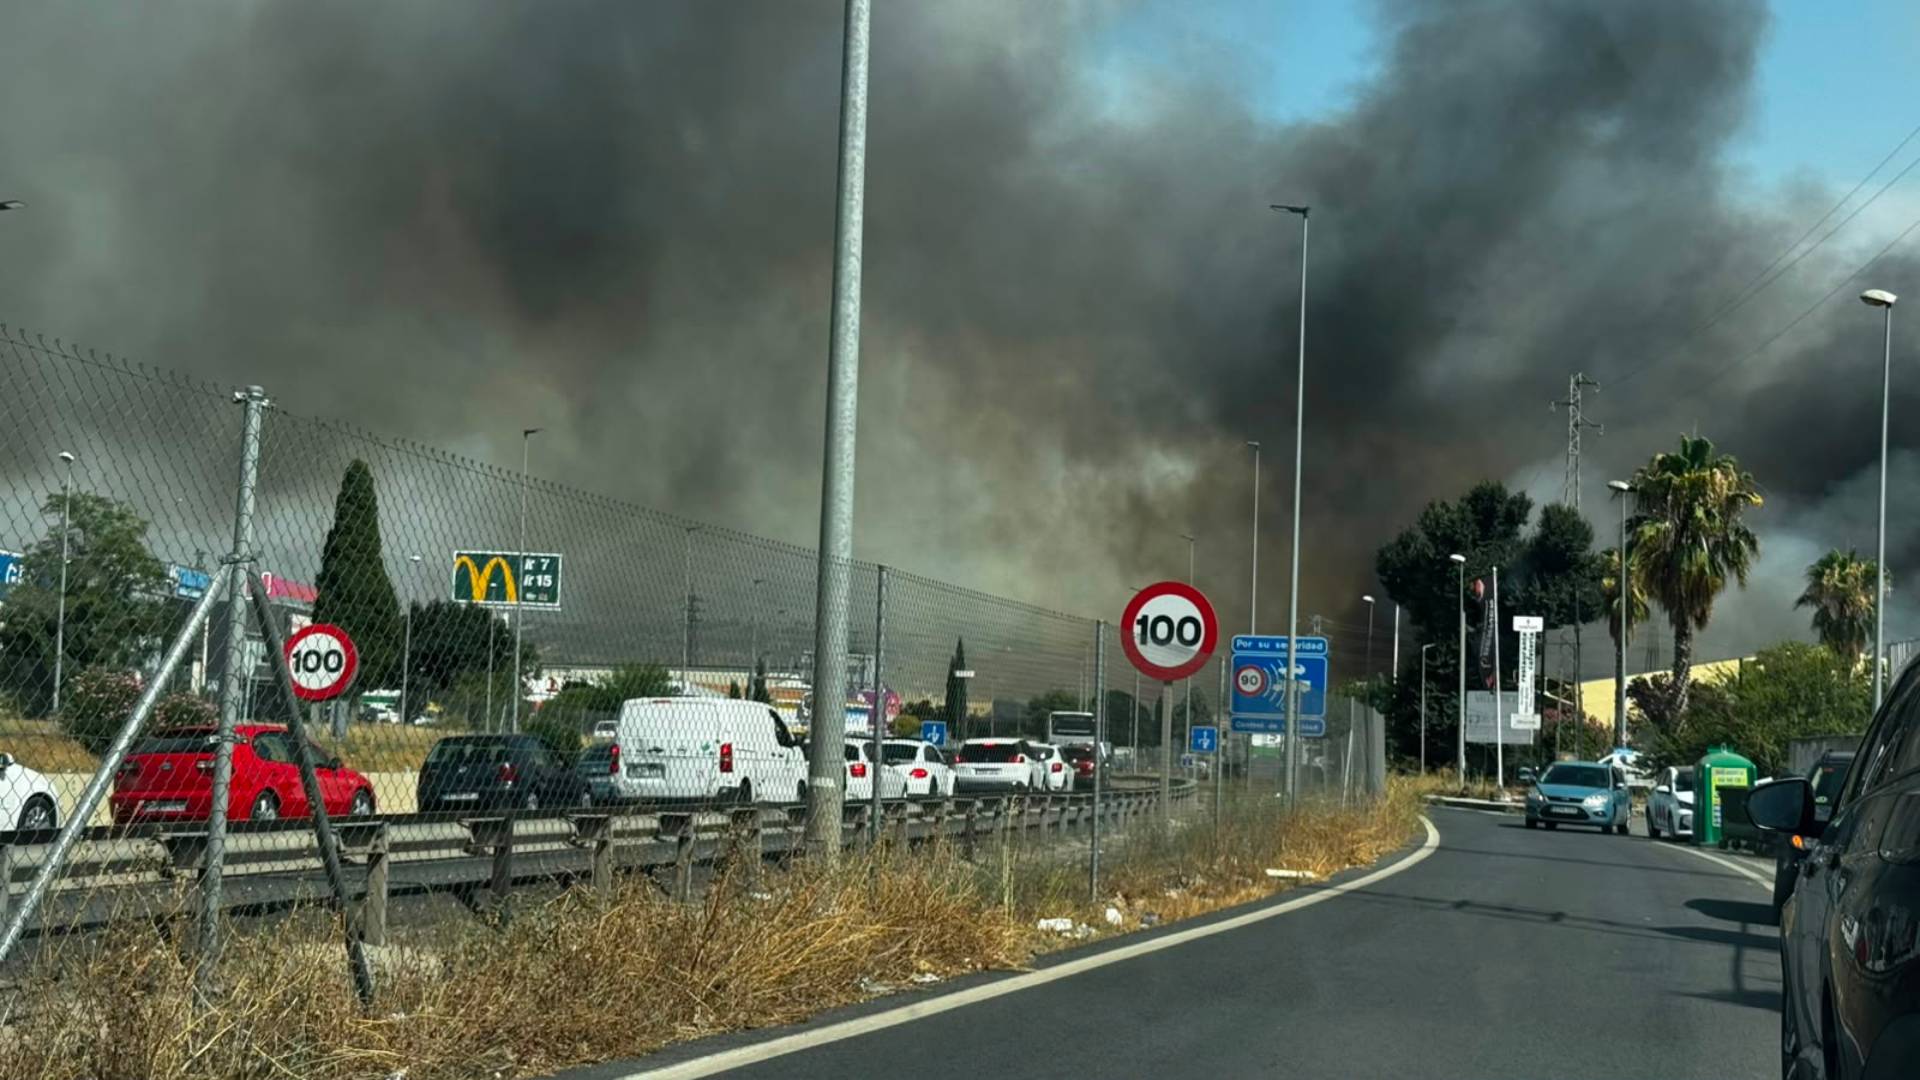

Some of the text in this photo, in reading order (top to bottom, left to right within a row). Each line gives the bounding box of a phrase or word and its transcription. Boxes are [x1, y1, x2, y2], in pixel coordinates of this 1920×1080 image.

[540, 558, 551, 571] 7
[536, 574, 553, 587] 15
[1136, 614, 1202, 647] 100
[1236, 639, 1252, 648] Por
[1258, 640, 1270, 649] su
[292, 649, 343, 673] 100
[1240, 674, 1259, 686] 90
